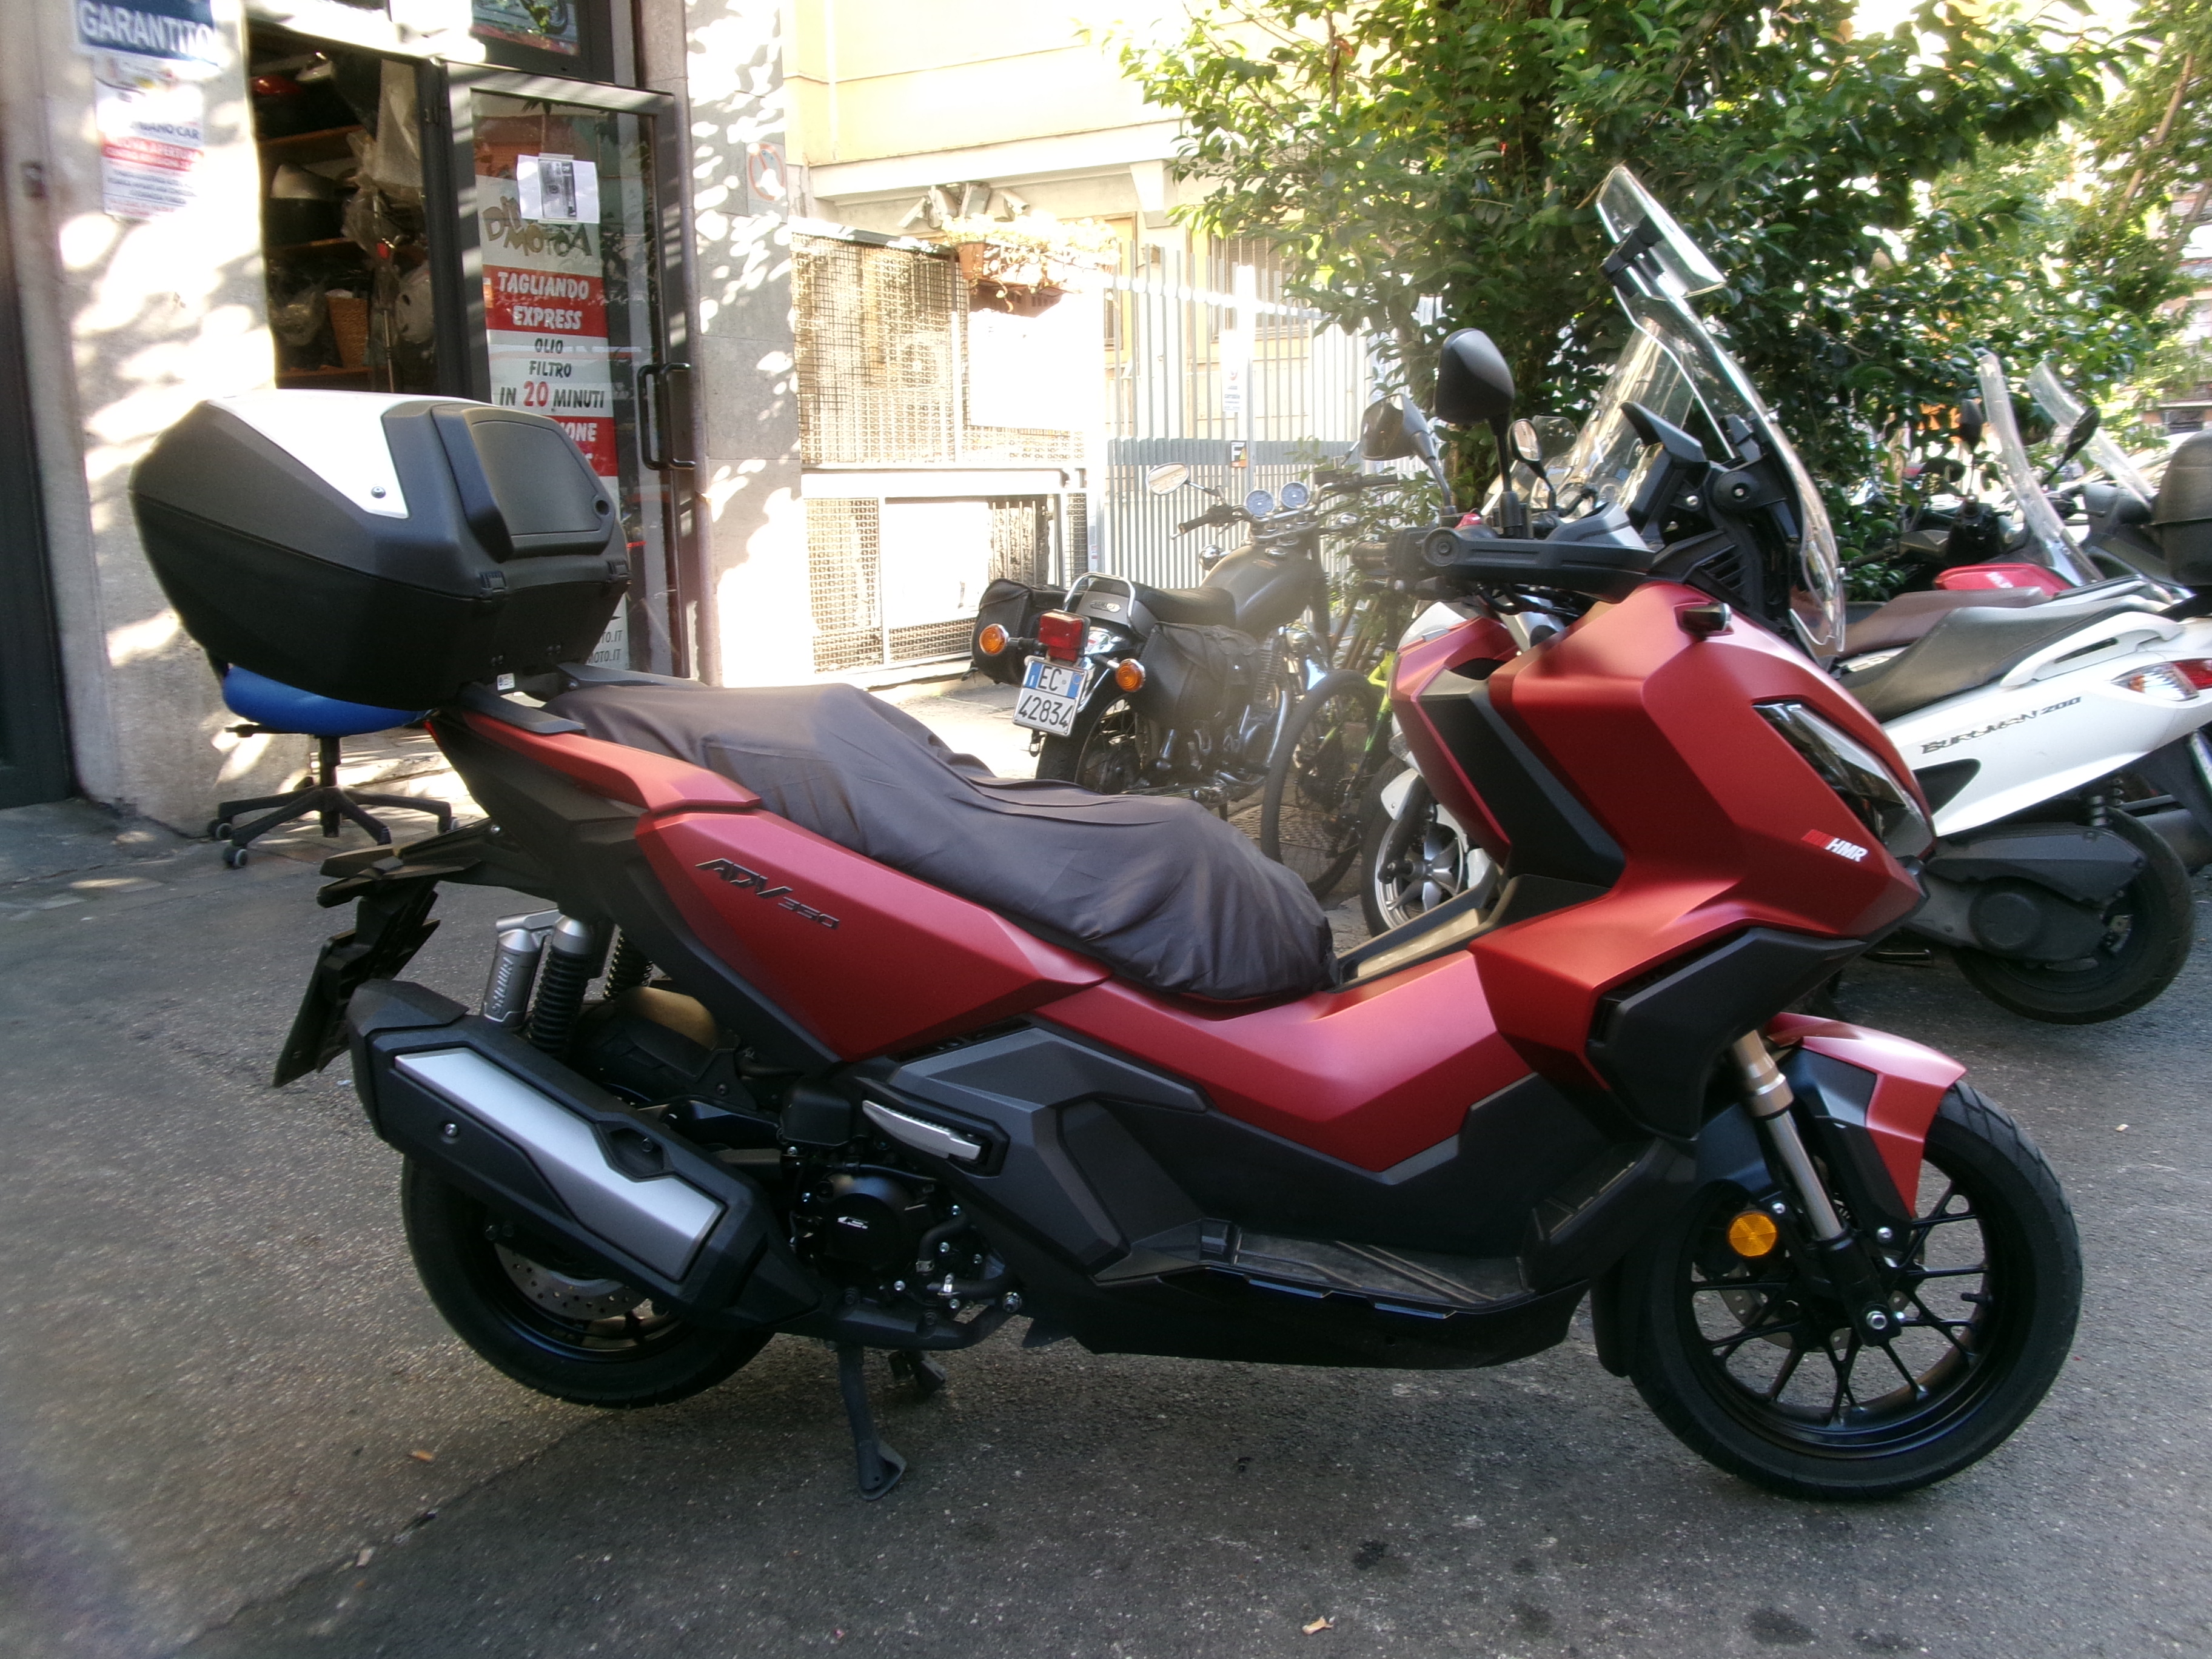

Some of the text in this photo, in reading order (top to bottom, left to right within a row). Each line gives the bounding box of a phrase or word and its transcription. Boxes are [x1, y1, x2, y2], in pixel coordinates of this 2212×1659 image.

[498, 272, 589, 300] TAGLIANDO
[512, 305, 583, 330] EXPRESS
[534, 338, 563, 354] OLIO
[529, 360, 572, 378] FILTRO
[499, 380, 605, 409] IN 20 MINUTI
[600, 630, 623, 643] TO.IT
[1037, 665, 1062, 691] EC
[1018, 695, 1073, 729] 42834
[1920, 696, 2082, 755] BURGMAN 200
[1825, 837, 1869, 862] HMR
[695, 857, 840, 930] ADV 350
